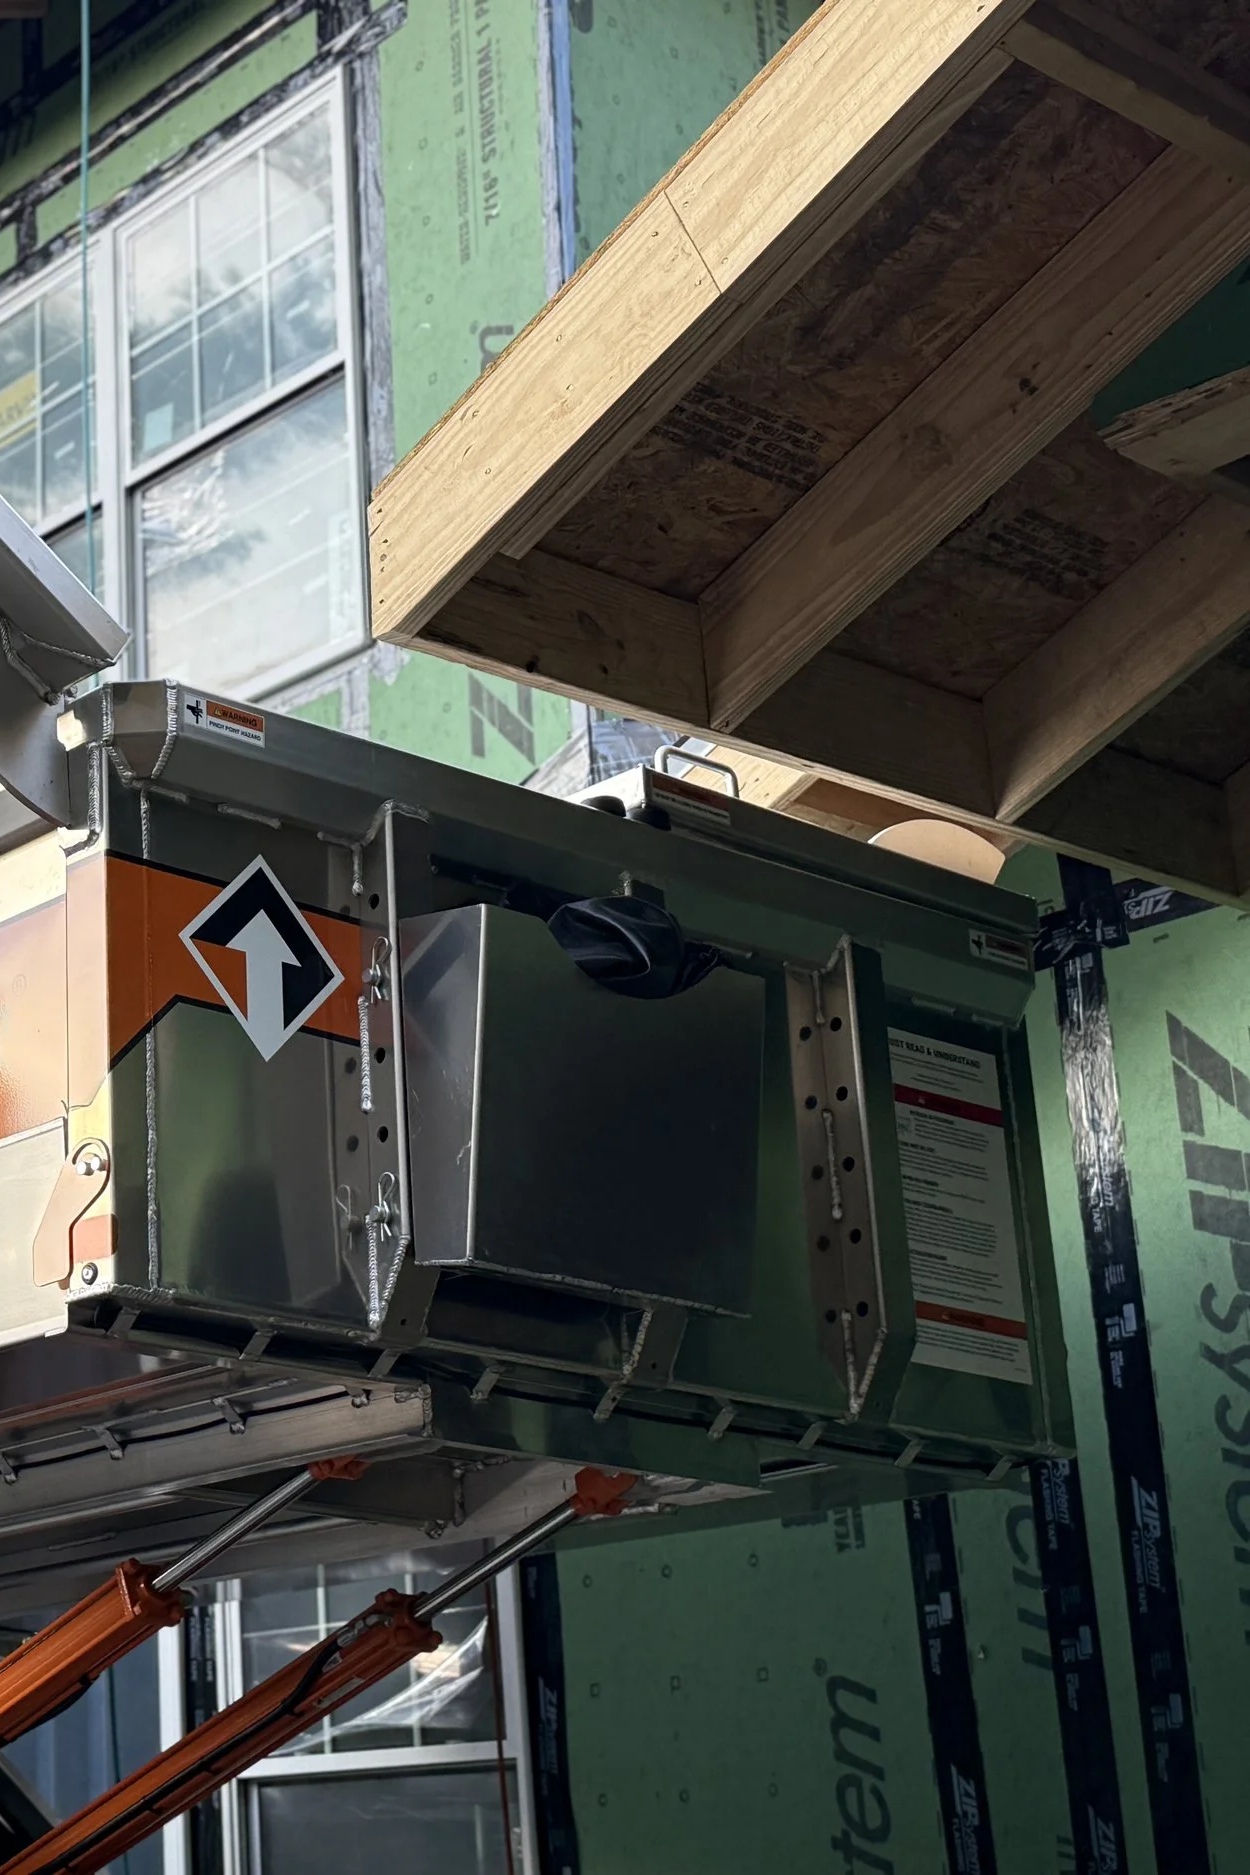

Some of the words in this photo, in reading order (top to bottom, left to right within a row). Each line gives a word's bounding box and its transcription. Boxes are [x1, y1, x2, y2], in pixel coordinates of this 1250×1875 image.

[475, 37, 498, 164] STRUCTURAL
[222, 709, 258, 727] WARNING
[1137, 1584, 1149, 1614] TAPE
